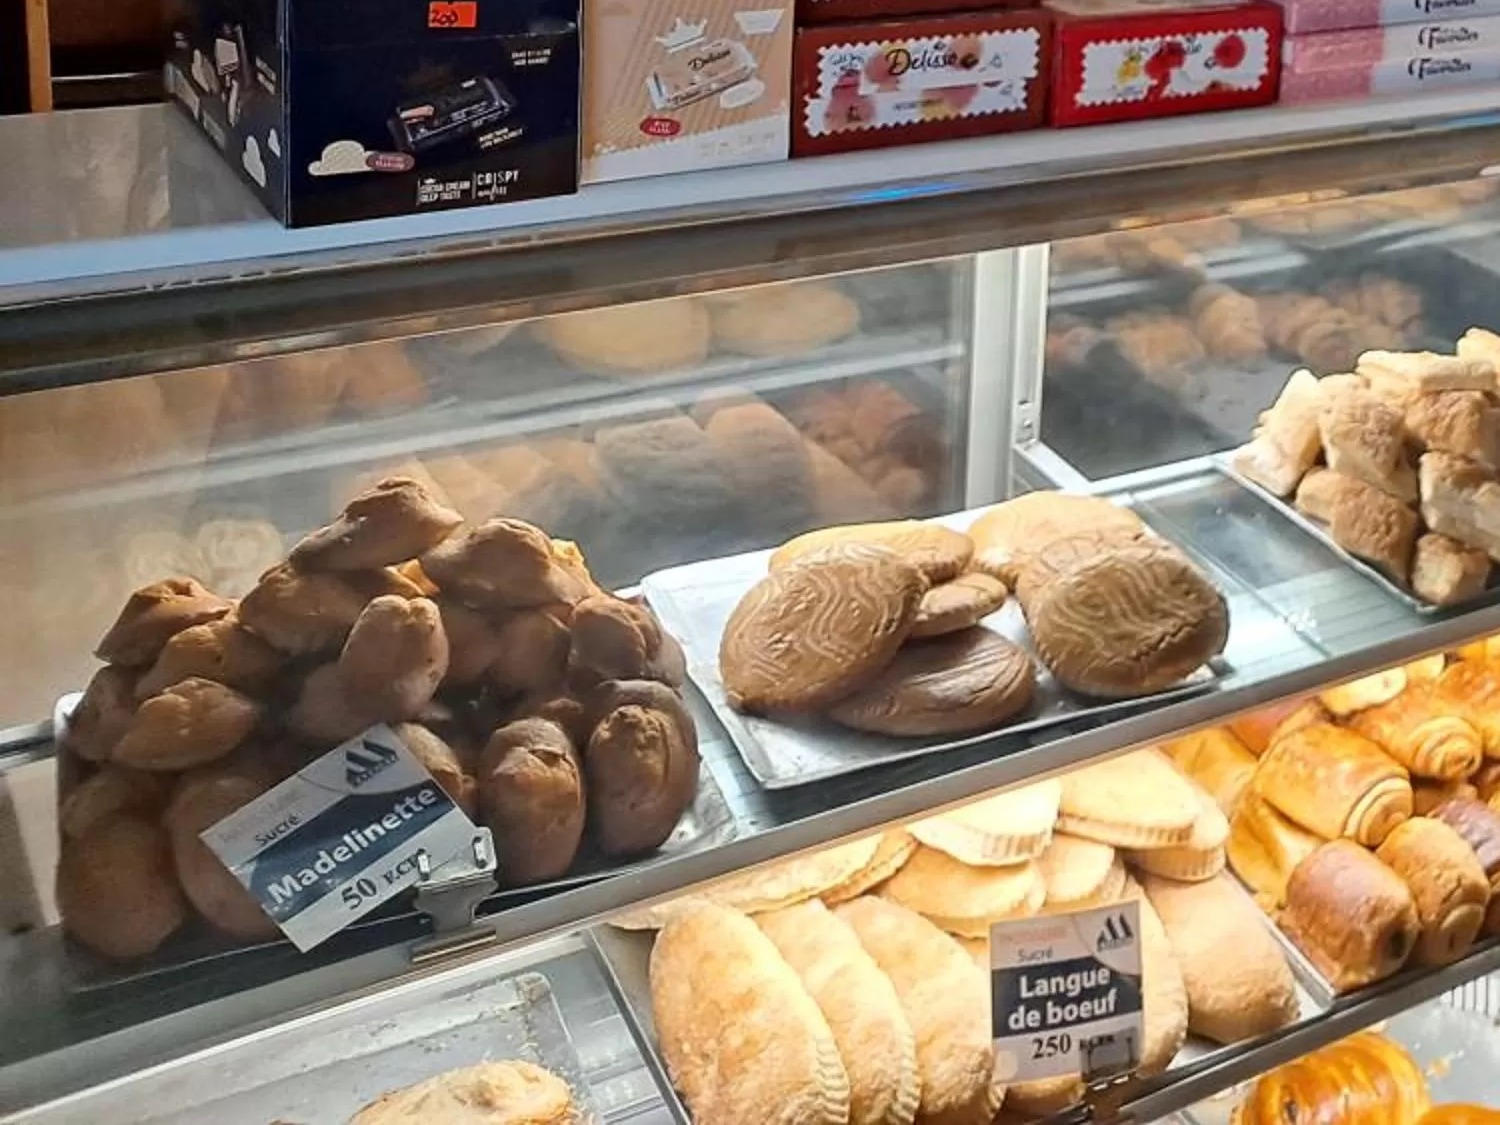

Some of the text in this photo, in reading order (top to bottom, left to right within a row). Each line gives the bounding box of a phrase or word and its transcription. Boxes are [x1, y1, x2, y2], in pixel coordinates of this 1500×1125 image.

[254, 812, 300, 846] Sucré
[266, 787, 438, 905] Madelinette
[341, 877, 378, 911] 50
[1019, 967, 1111, 1000] Langue
[1008, 987, 1118, 1030] de boeuf
[1031, 1033, 1072, 1060] 250
